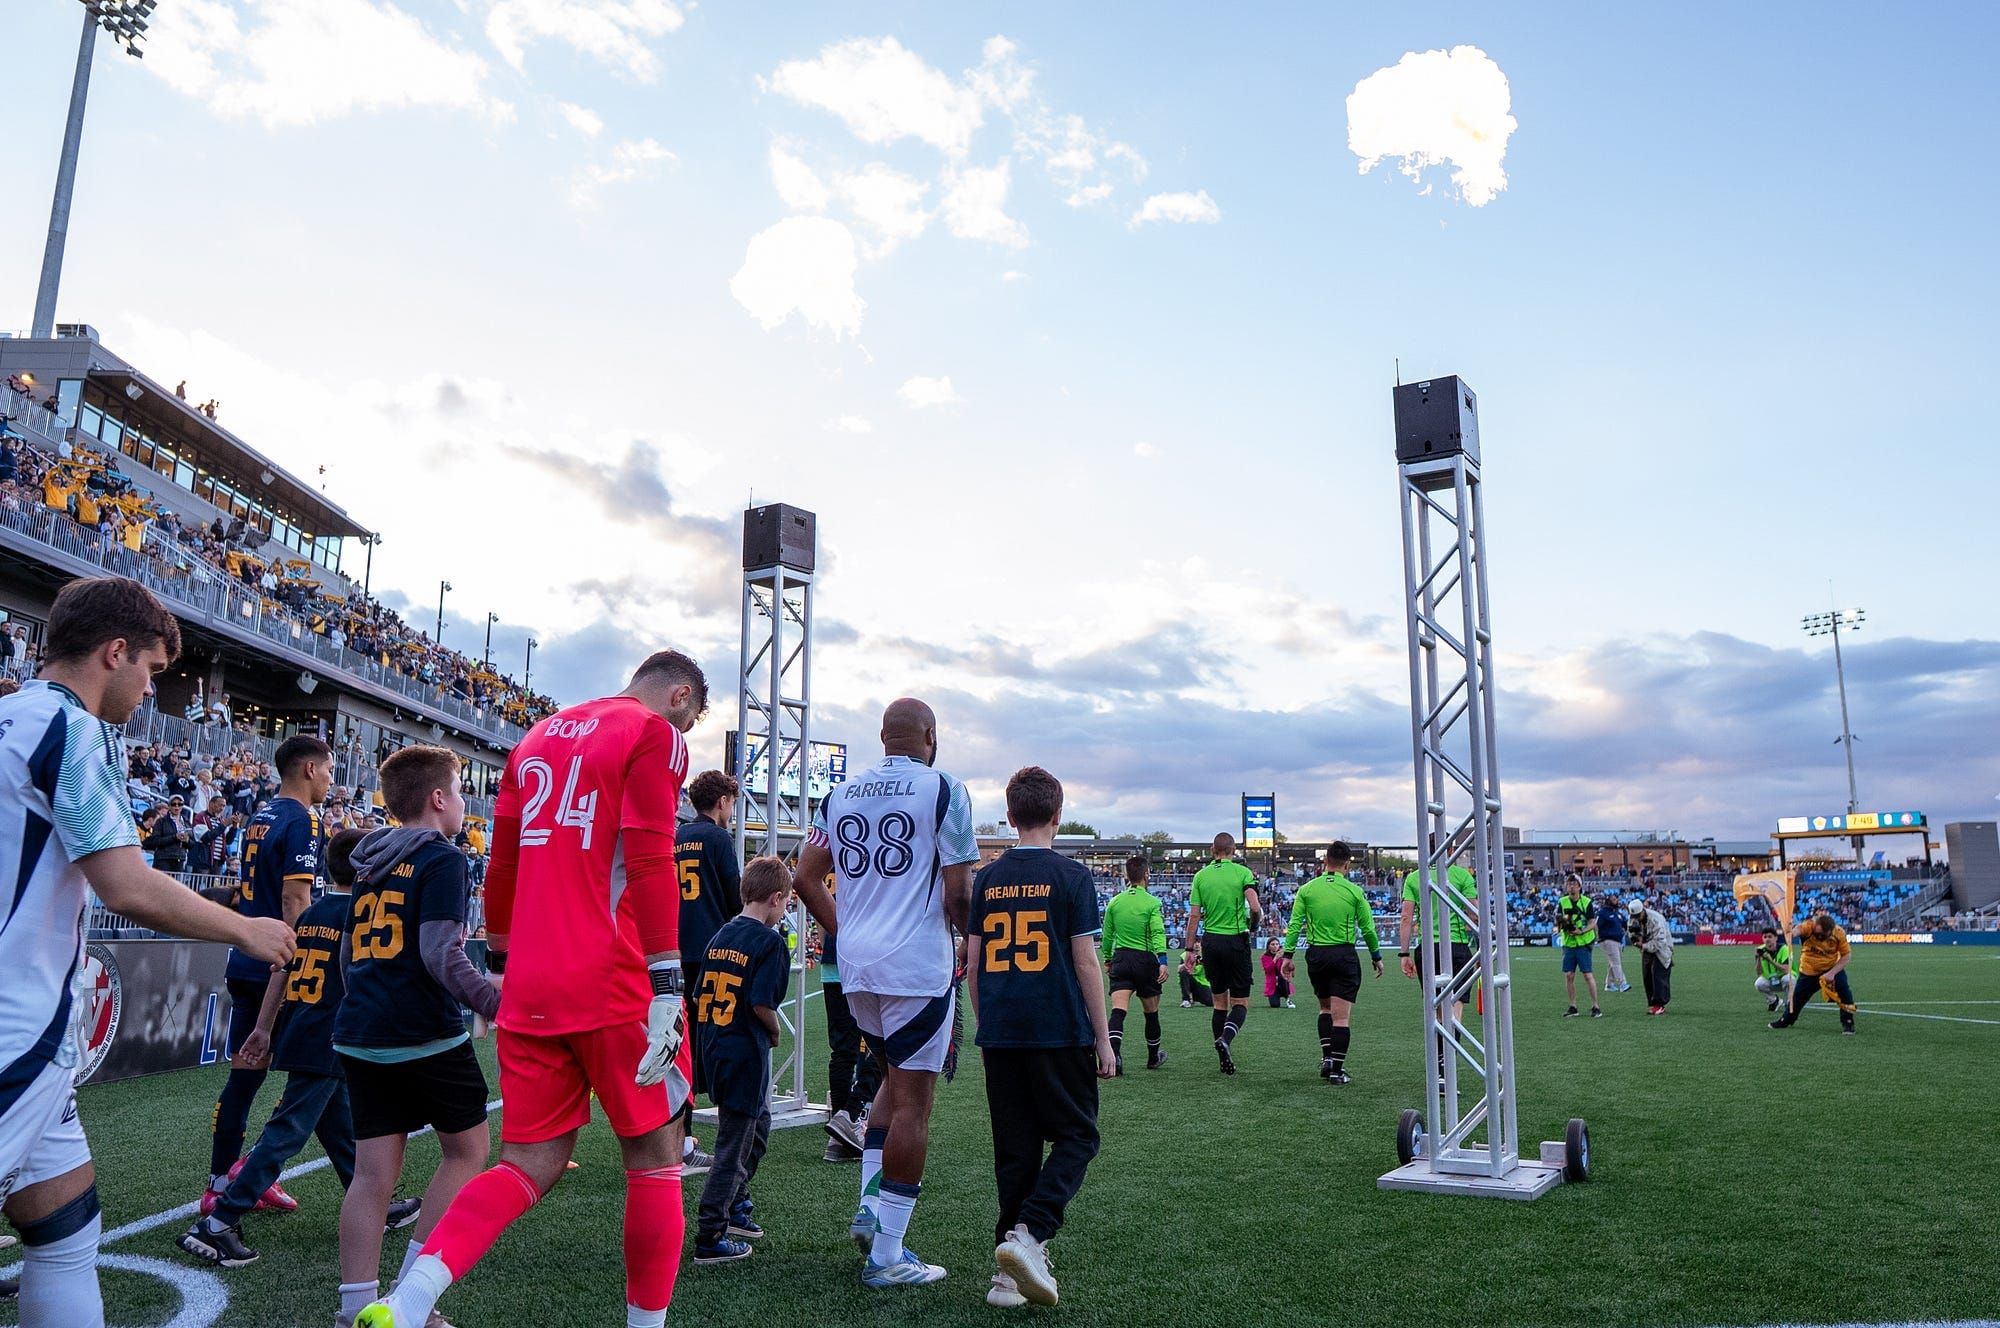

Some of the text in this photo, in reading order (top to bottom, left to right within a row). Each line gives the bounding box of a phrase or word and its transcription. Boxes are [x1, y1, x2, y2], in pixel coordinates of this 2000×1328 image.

[544, 718, 599, 738] BOND
[518, 755, 598, 850] 24
[845, 780, 916, 799] FARRELL
[836, 810, 916, 880] 88
[676, 859, 700, 901] 5
[1021, 884, 1051, 898] TEAM
[297, 926, 341, 942] REAM TEAM
[351, 890, 405, 963] 25
[983, 910, 1050, 973] 25
[286, 948, 331, 1004] 25
[728, 950, 749, 967] TEAM
[697, 970, 743, 1027] 25
